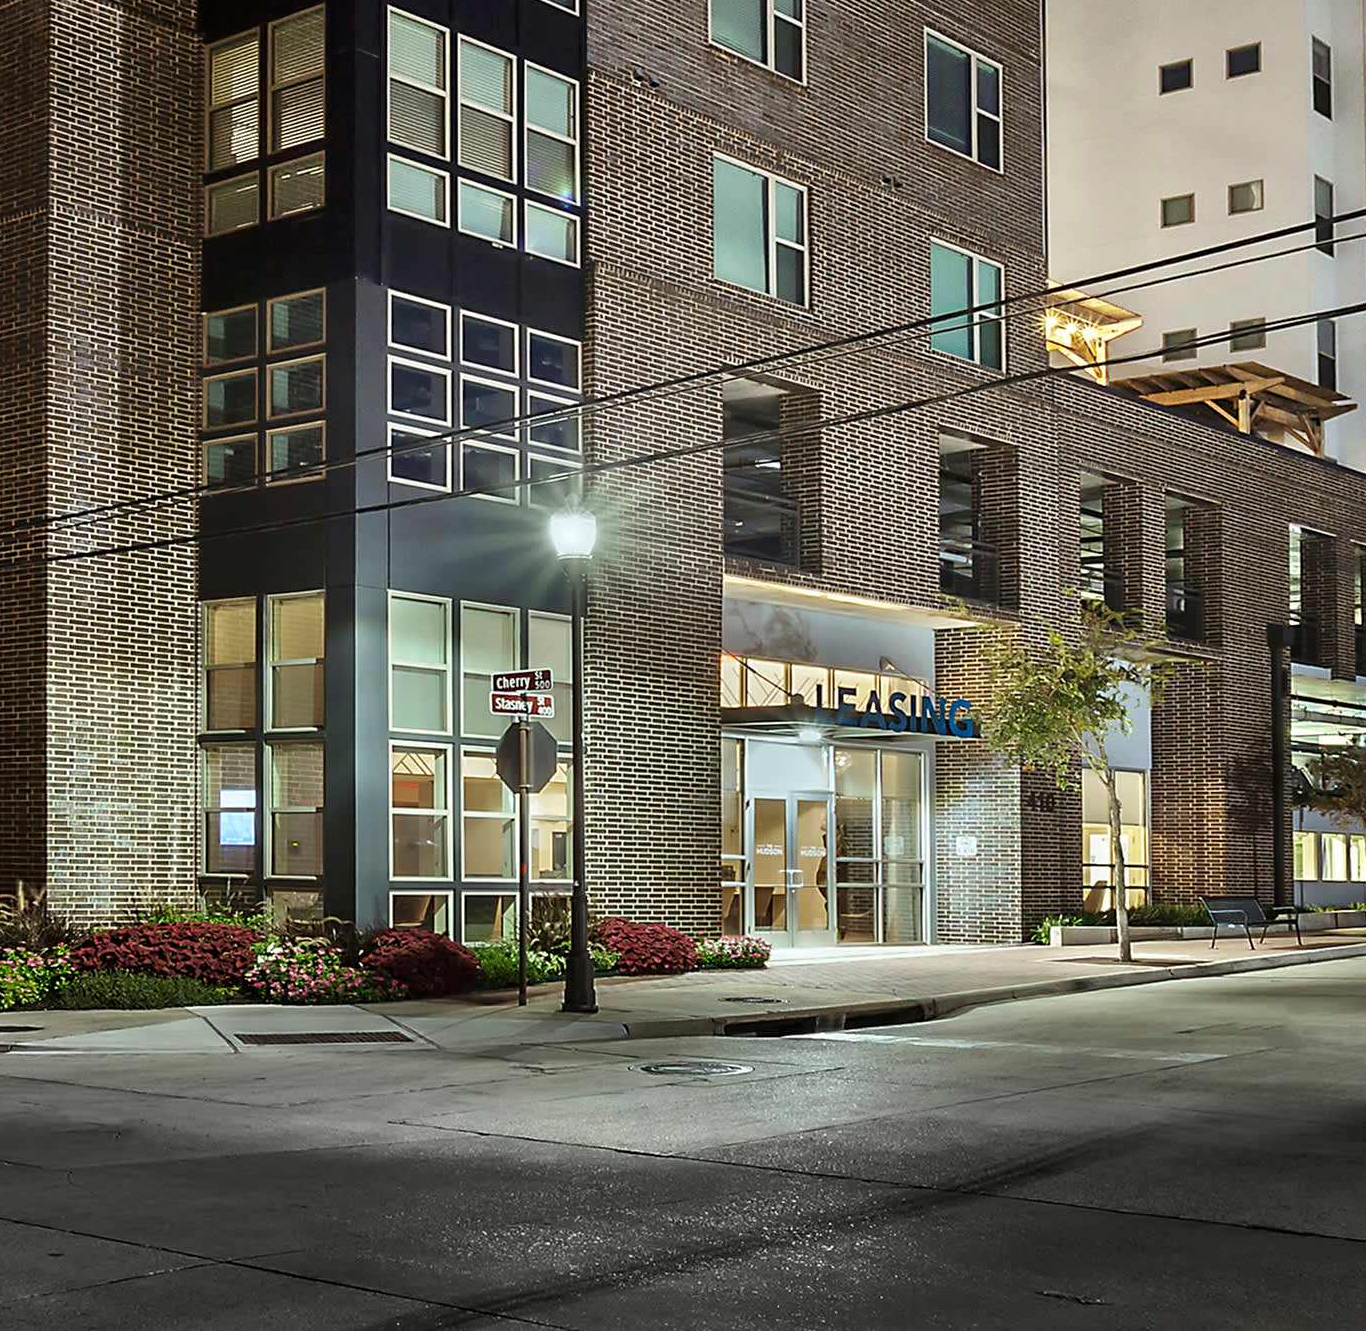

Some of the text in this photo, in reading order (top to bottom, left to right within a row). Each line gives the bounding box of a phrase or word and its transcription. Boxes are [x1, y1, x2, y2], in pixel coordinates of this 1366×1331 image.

[496, 670, 543, 690] Cherry St
[535, 680, 551, 689] 500
[495, 697, 533, 714] Stasney
[815, 683, 974, 738] LEASING
